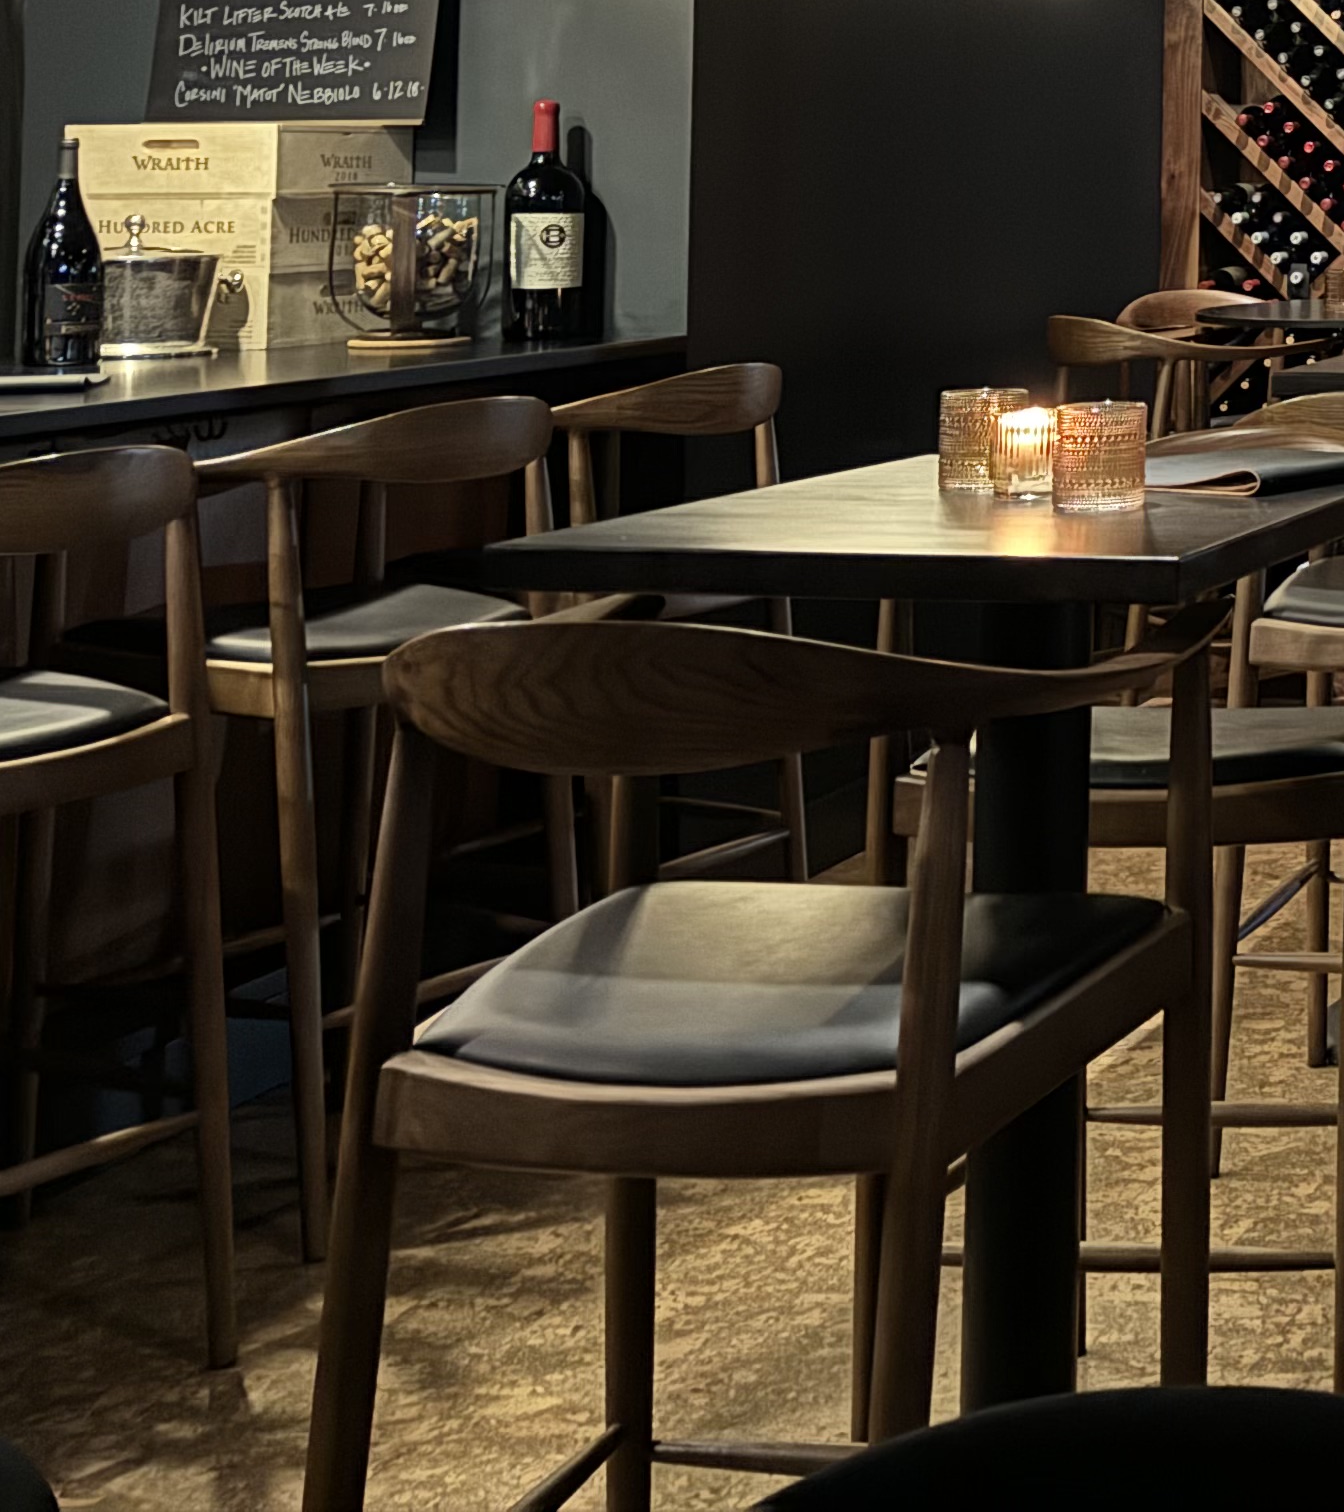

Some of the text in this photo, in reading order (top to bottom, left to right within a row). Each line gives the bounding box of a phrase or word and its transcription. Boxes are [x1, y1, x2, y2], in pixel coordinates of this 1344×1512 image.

[179, 4, 218, 28] KILT
[261, 59, 283, 77] OF
[282, 57, 312, 78] THE
[132, 156, 210, 171] WRAITH
[320, 154, 372, 169] WRAITH
[191, 220, 235, 234] ACRE
